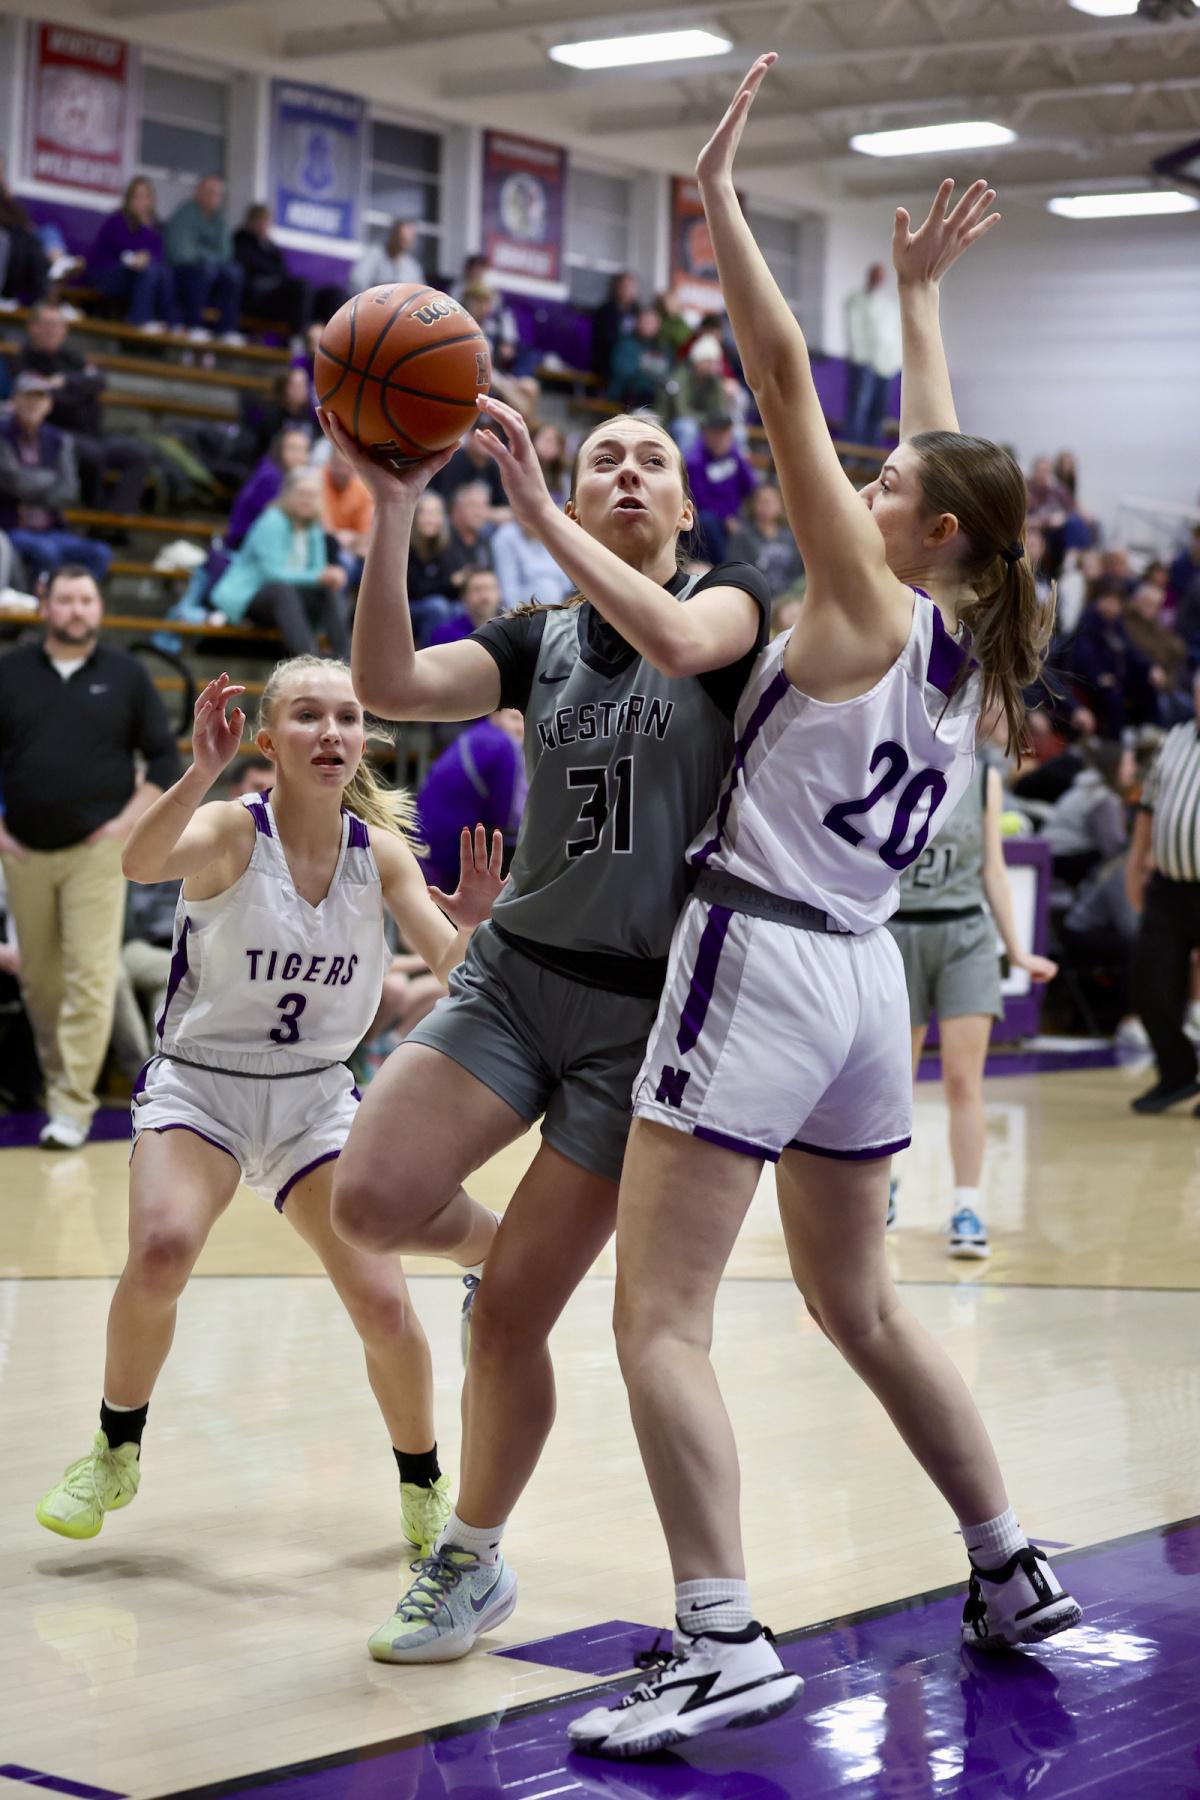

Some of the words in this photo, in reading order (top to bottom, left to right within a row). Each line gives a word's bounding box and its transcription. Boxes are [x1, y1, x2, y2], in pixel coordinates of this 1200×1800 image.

[566, 755, 634, 860] 31
[822, 740, 948, 871] 20
[912, 843, 957, 889] 21
[246, 950, 358, 986] TIGERS
[269, 992, 307, 1044] 3
[655, 1065, 691, 1109] N
